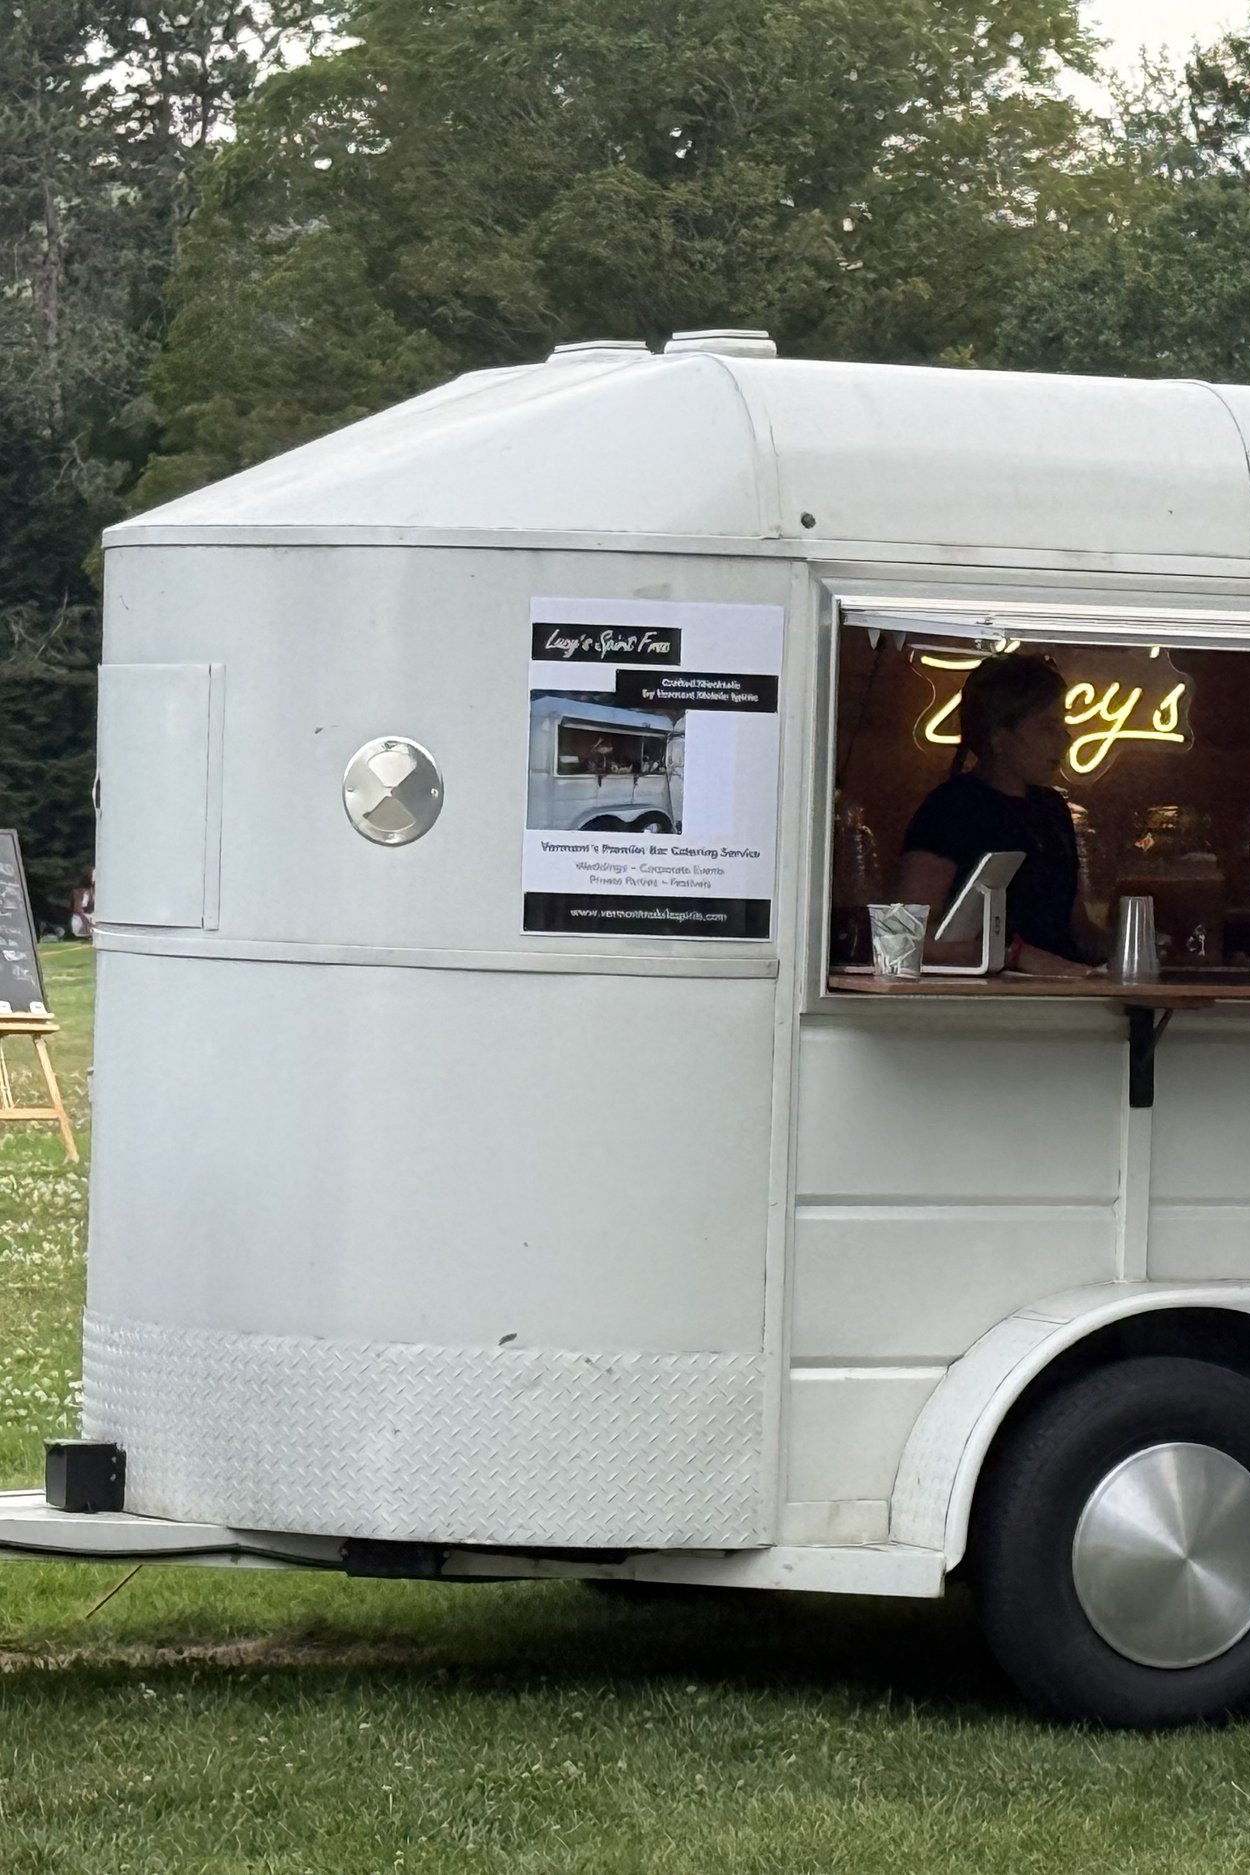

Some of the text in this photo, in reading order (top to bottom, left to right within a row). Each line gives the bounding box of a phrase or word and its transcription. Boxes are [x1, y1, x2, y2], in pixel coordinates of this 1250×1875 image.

[544, 629, 593, 658] Lucy's
[540, 840, 599, 854] Vermont's
[671, 845, 719, 859] Catering
[720, 846, 761, 859] Service
